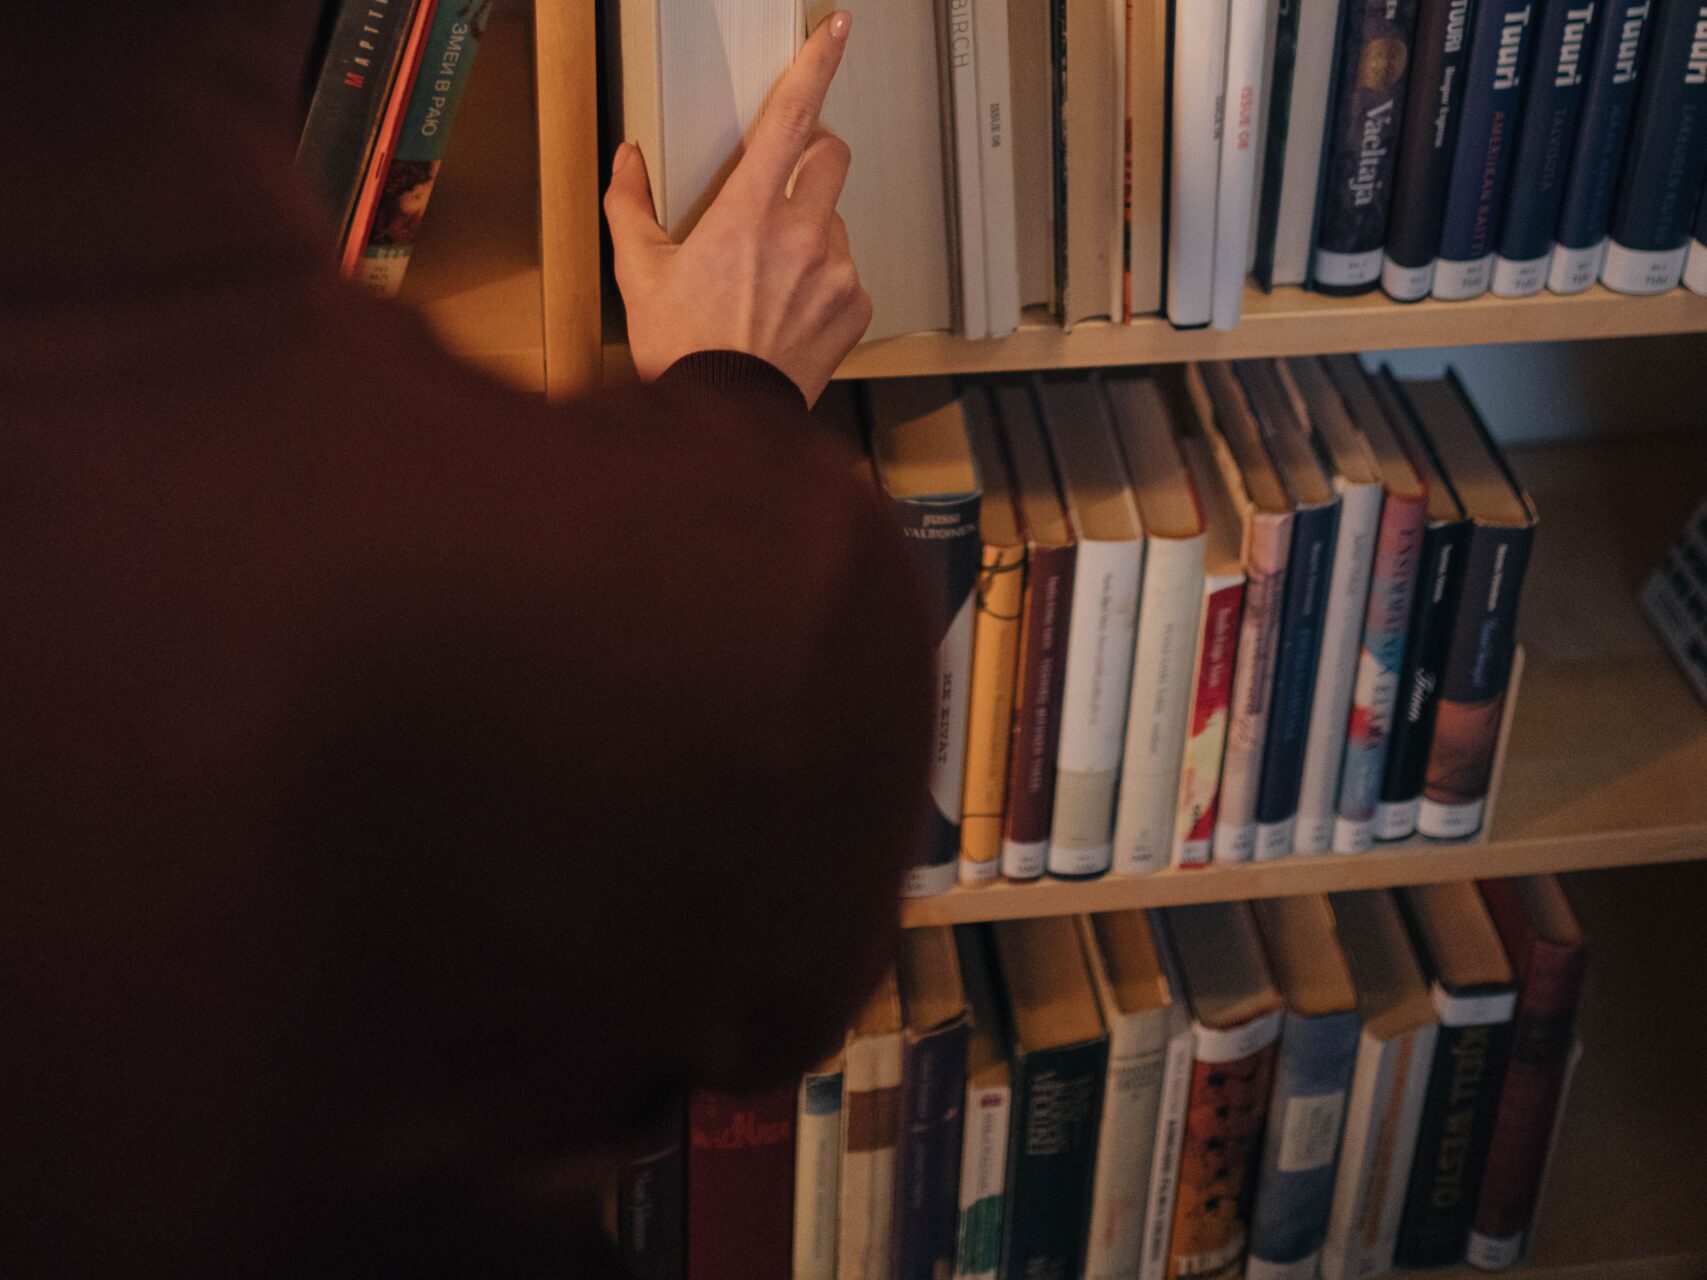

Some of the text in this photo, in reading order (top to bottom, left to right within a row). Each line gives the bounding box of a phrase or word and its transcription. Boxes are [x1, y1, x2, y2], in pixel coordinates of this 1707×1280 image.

[421, 22, 468, 137] ЗМЕИ В РАЮ
[1493, 3, 1532, 91] Tuuri
[1554, 1, 1595, 88] Tuuri
[990, 103, 1001, 134] ISSUE
[1238, 85, 1253, 129] ISSUE
